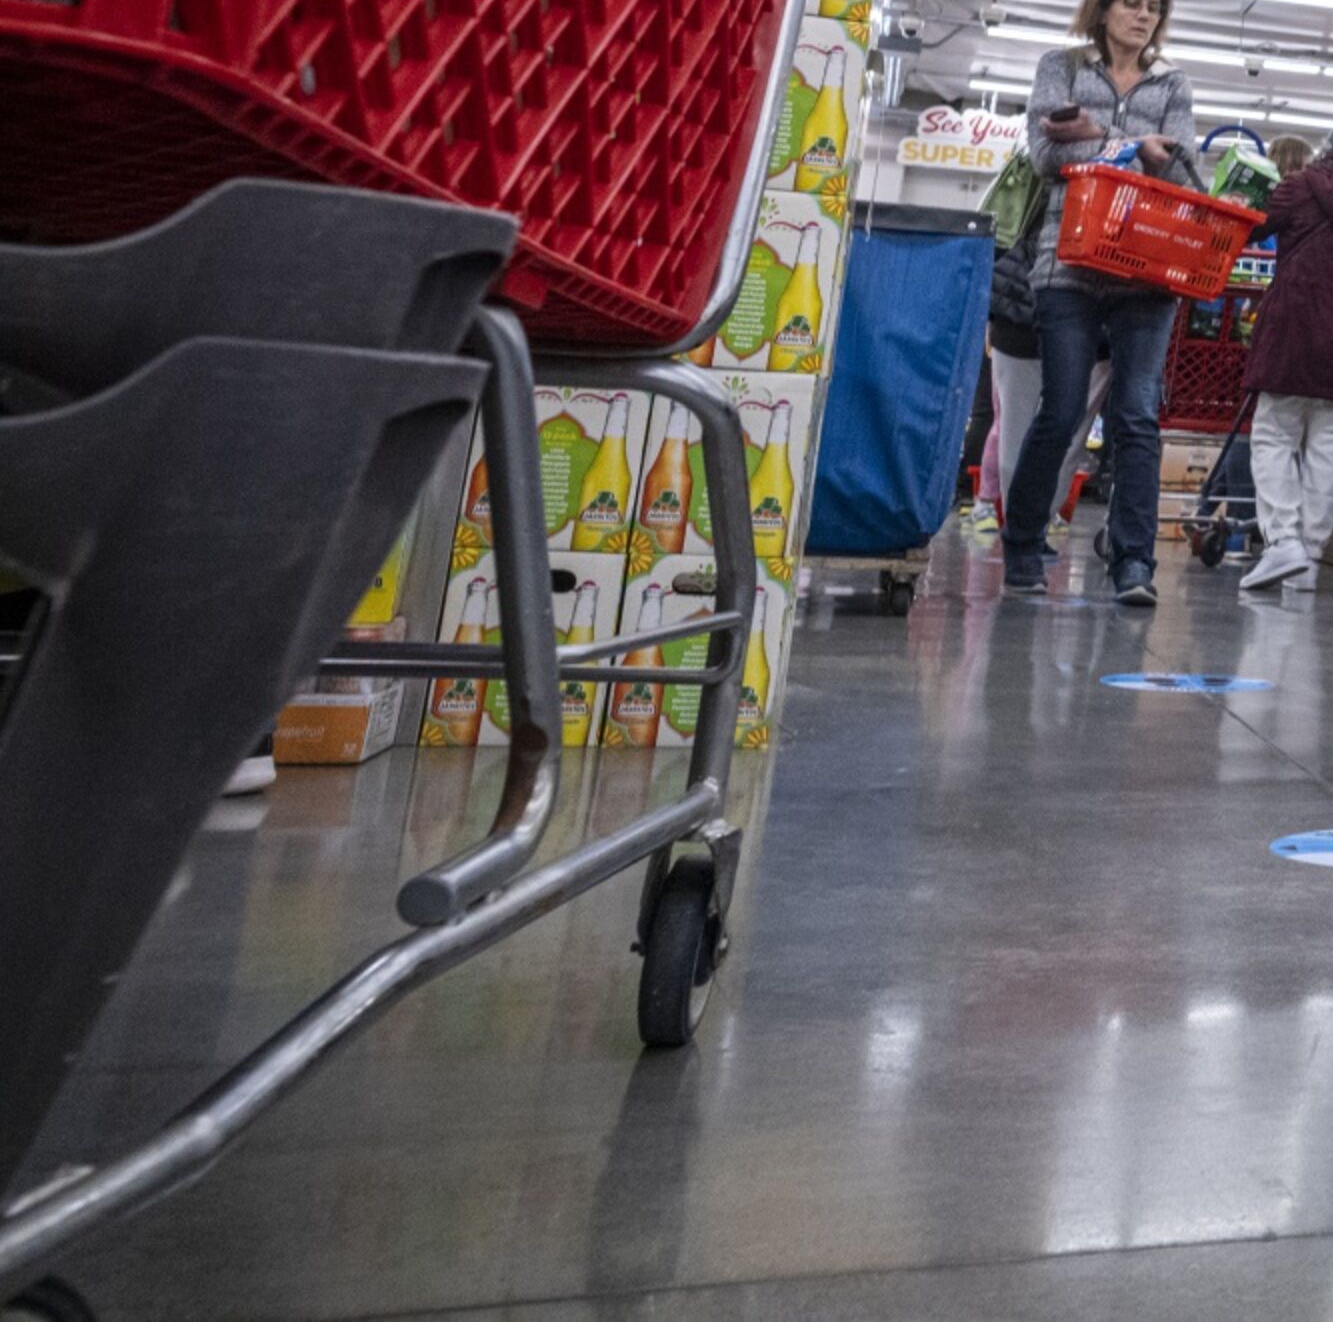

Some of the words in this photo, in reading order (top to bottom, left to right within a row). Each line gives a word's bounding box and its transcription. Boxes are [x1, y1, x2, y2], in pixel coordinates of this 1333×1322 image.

[921, 109, 963, 134] See
[968, 115, 1021, 145] You
[903, 140, 994, 167] SUPER
